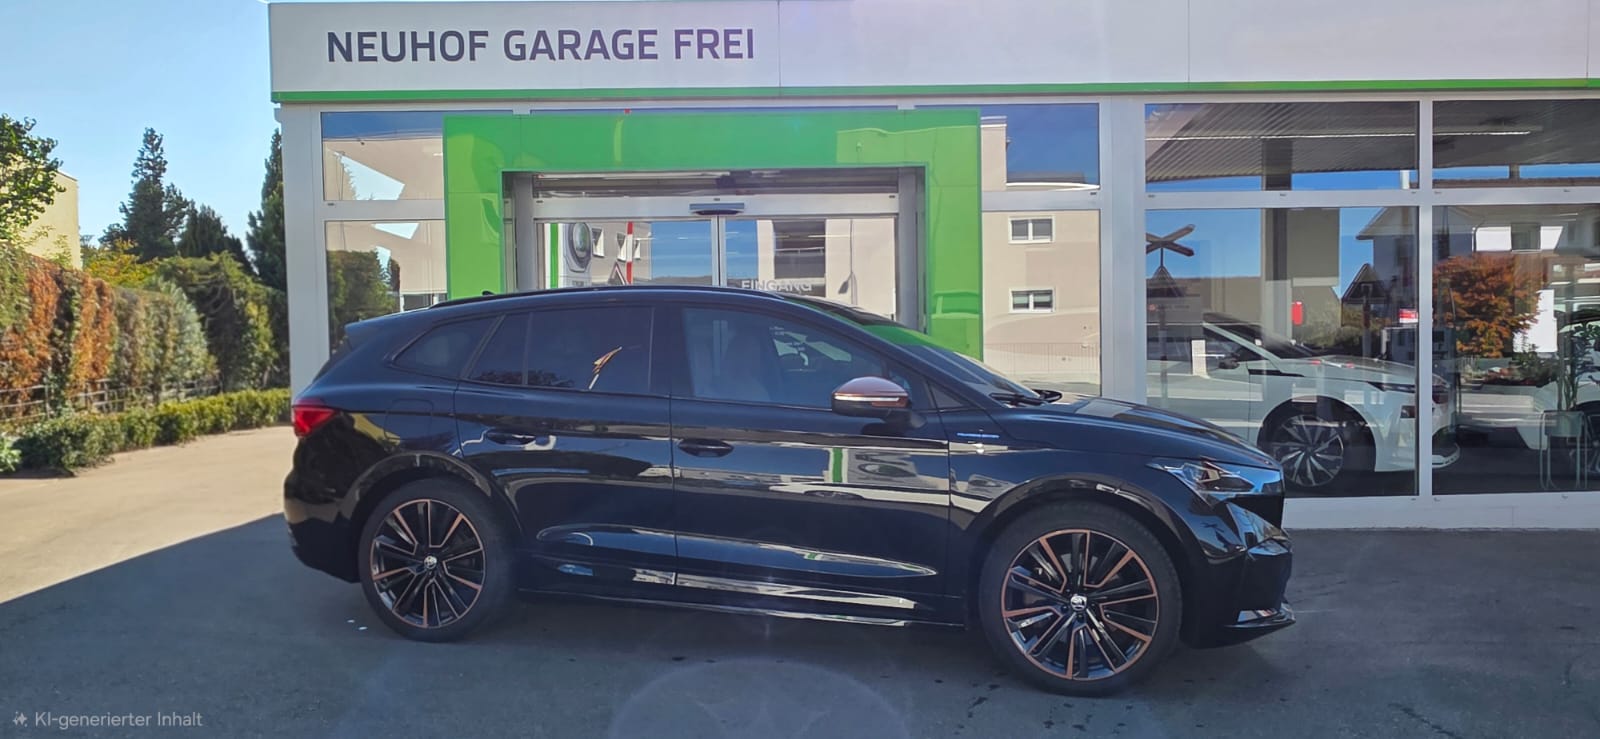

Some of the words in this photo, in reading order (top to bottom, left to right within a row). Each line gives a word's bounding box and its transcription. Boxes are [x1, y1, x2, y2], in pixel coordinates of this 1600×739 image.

[327, 30, 489, 63] NEUHOF
[503, 28, 659, 61] GARAGE
[673, 27, 755, 60] FREI
[741, 280, 812, 292] EINGANG
